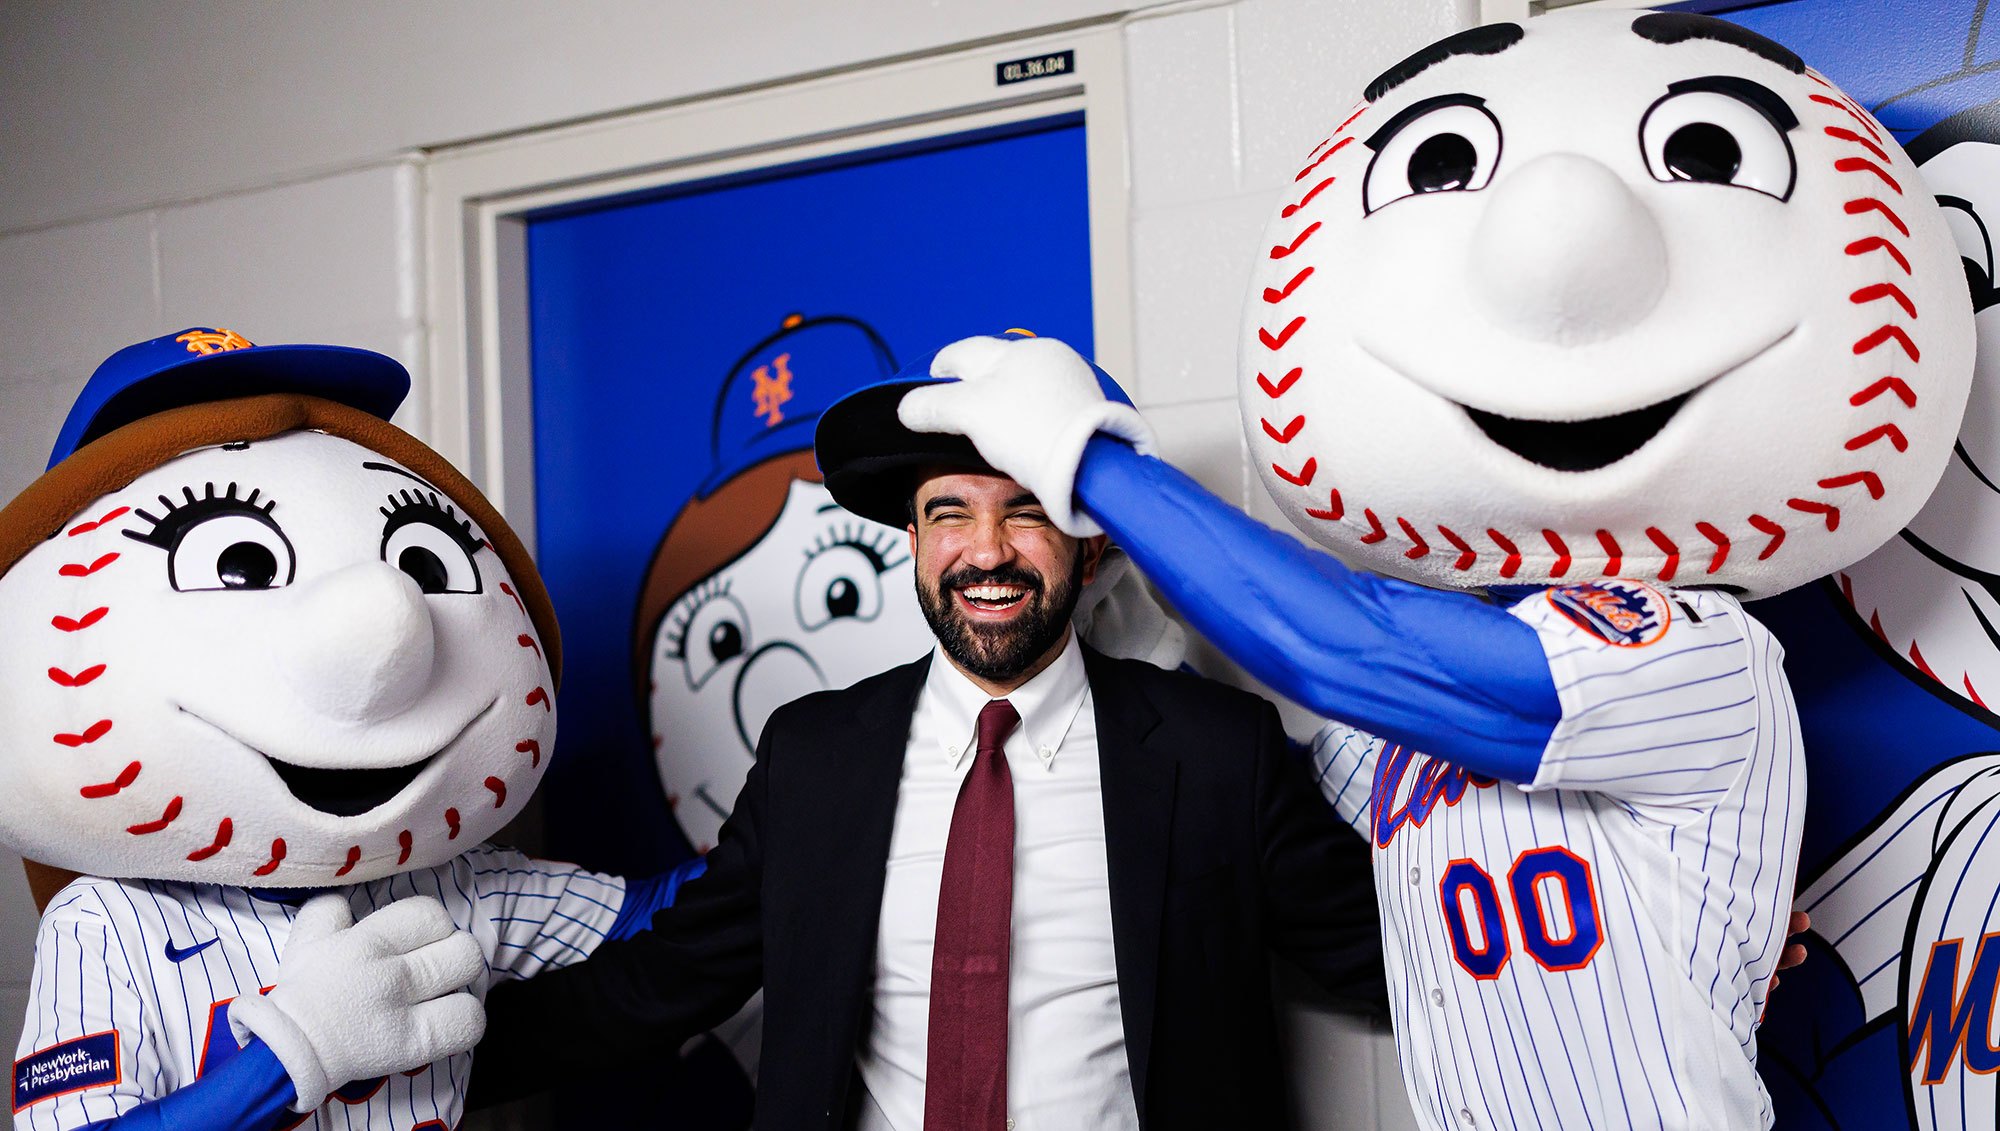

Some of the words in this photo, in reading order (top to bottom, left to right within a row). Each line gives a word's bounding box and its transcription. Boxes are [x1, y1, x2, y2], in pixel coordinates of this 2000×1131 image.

[1440, 845, 1604, 980] 00
[31, 1048, 90, 1076] NewYork-
[31, 1059, 110, 1089] Presbyterian
